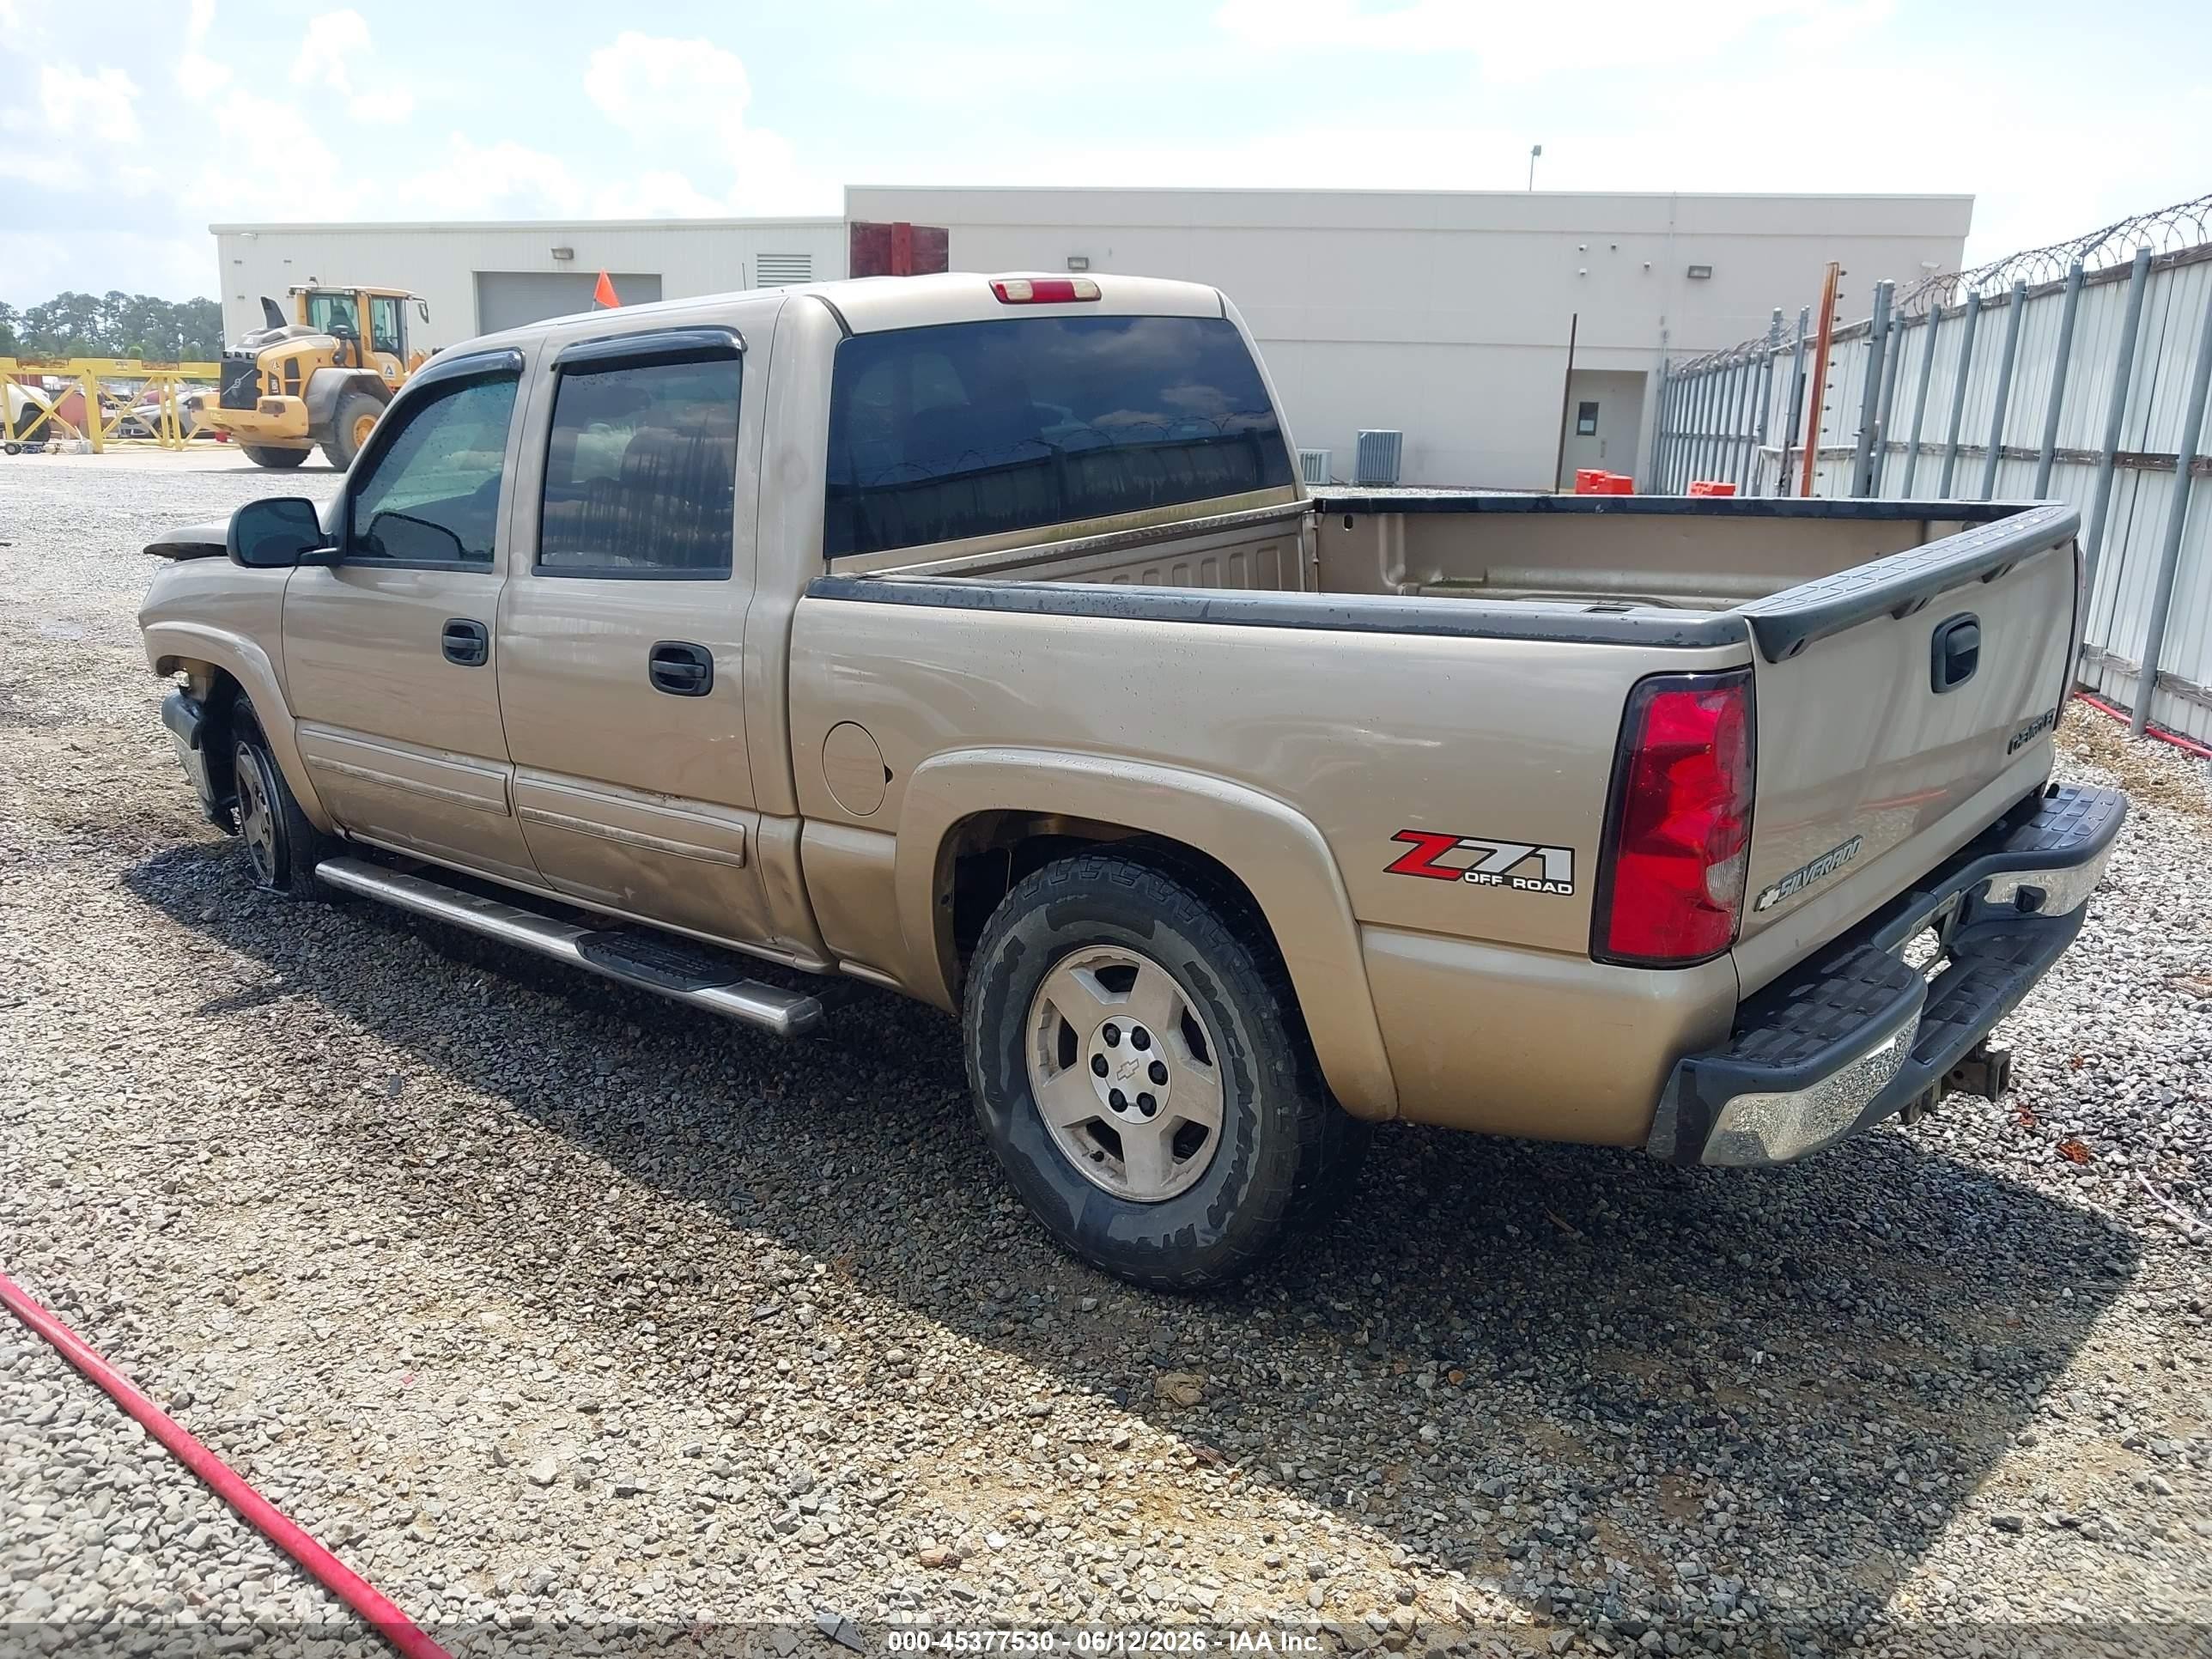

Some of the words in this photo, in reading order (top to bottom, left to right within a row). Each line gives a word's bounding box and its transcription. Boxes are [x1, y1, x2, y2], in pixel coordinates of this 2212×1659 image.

[1382, 830, 1575, 881] Z71
[1778, 836, 1863, 902] SILVERADO
[1464, 871, 1504, 886] OFF
[1512, 877, 1573, 896] ROAD
